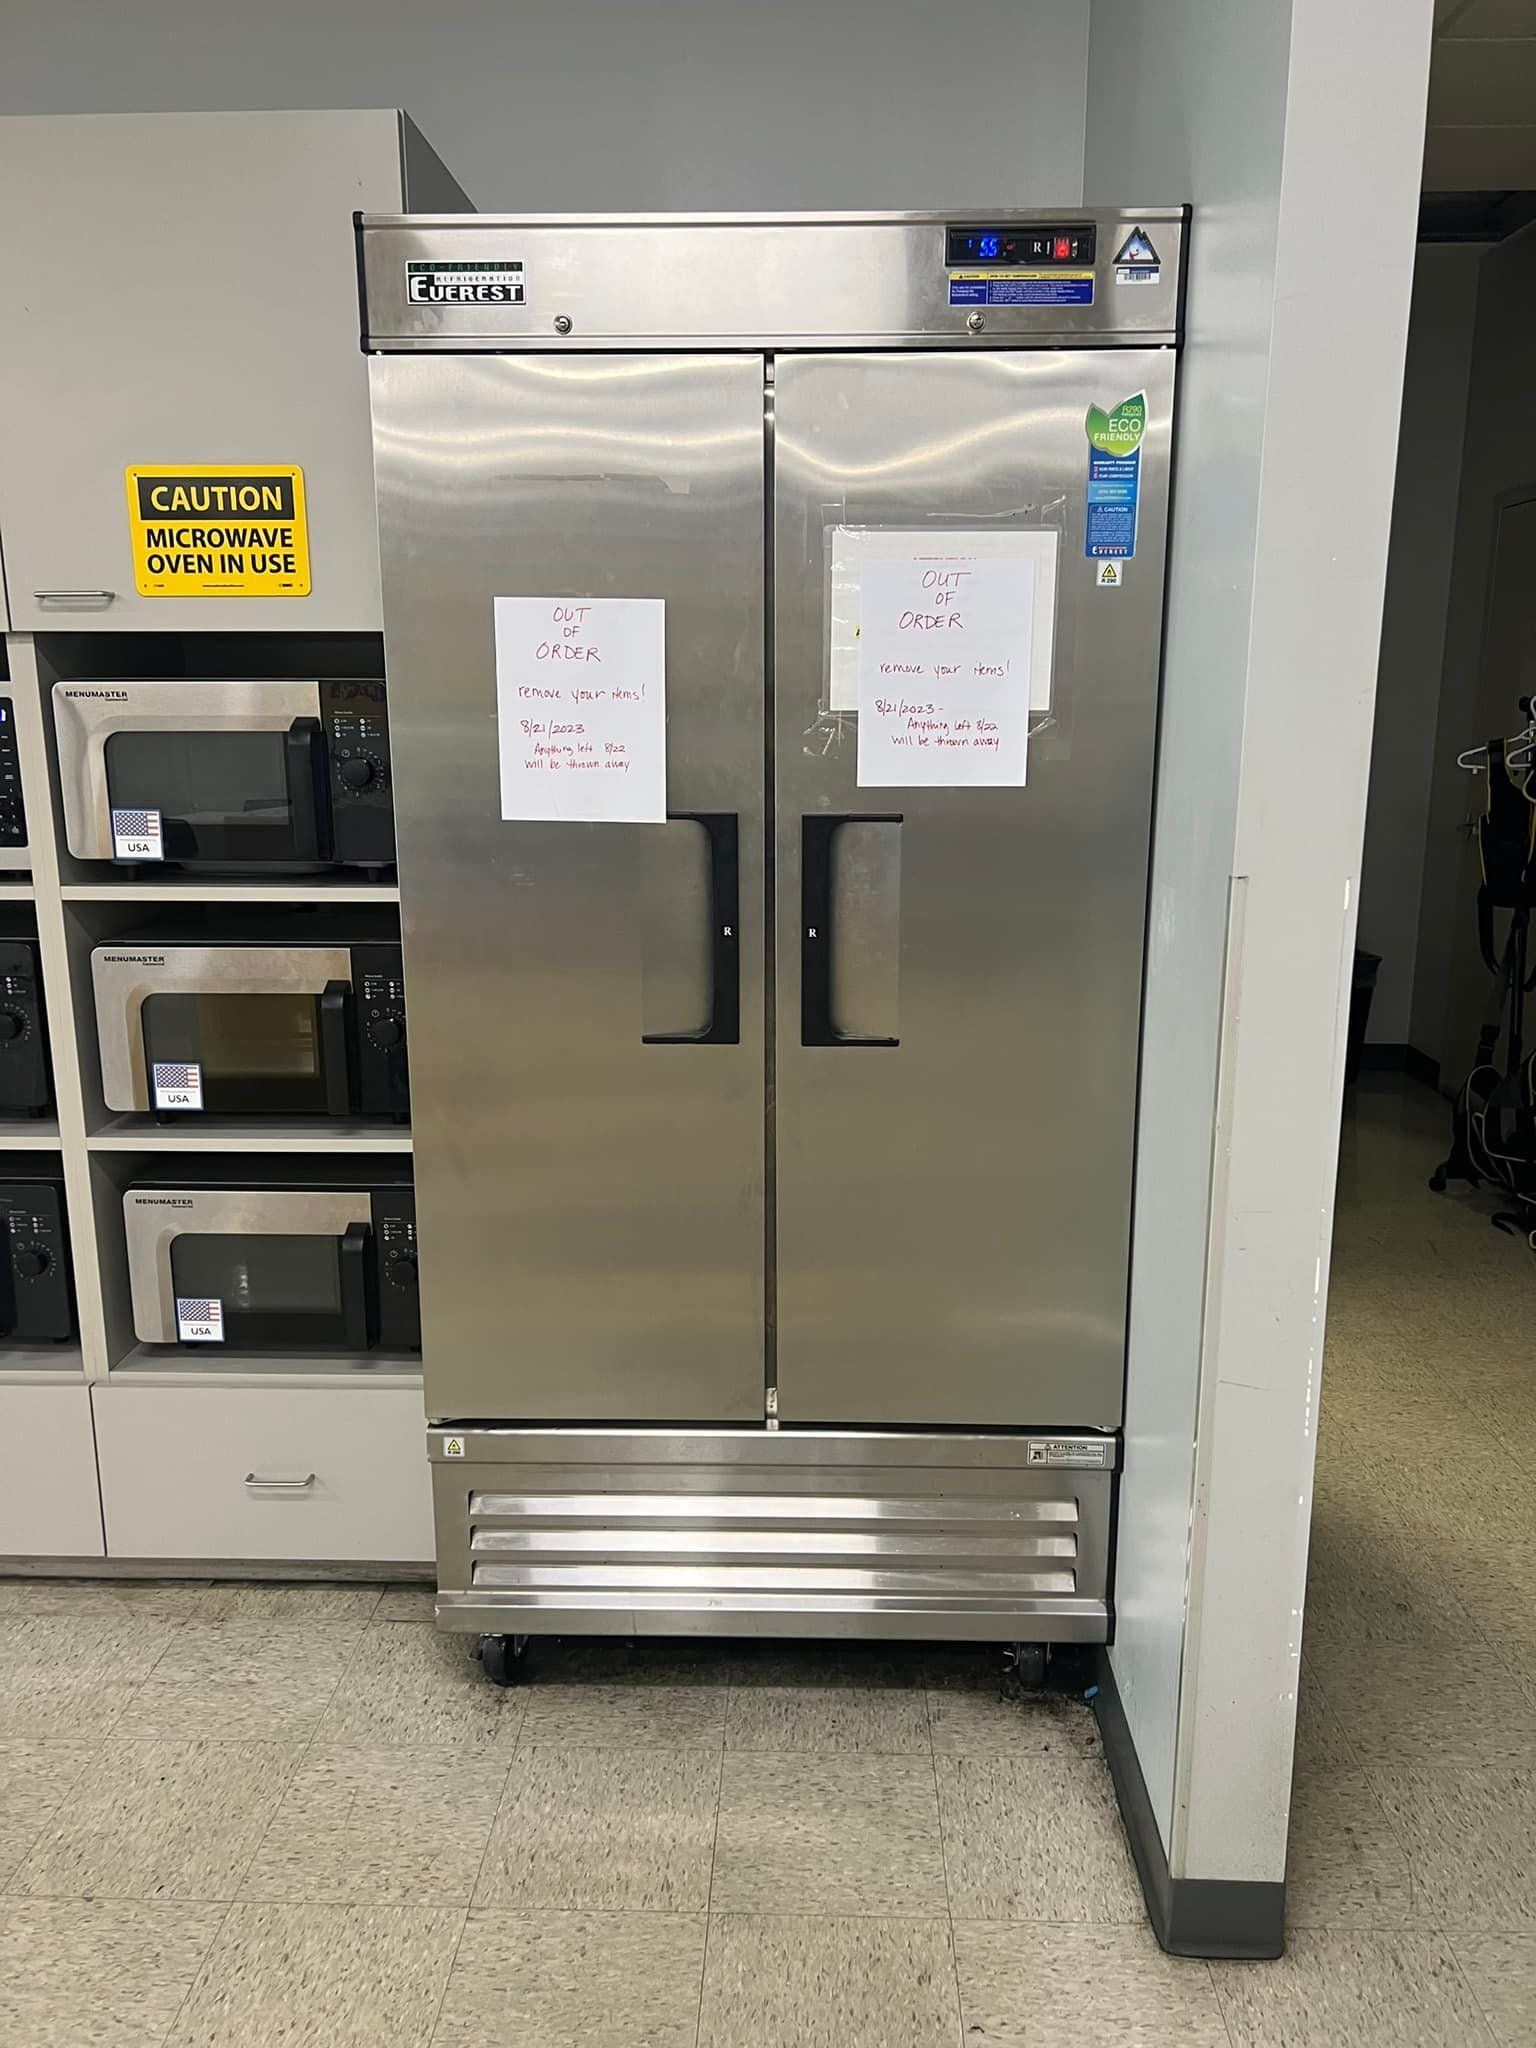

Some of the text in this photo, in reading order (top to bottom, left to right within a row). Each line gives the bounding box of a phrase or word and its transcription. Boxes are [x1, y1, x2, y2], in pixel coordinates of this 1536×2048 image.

[1033, 242, 1042, 253] R
[410, 276, 521, 301] EVEREST
[1109, 419, 1141, 432] ECO
[1094, 433, 1140, 441] FRIENDLY
[151, 486, 282, 512] CAUTION
[146, 528, 293, 549] MICROWAVE
[147, 554, 296, 574] OVEN IN USE
[921, 570, 971, 588] OUT
[935, 591, 957, 606] OF
[552, 607, 592, 622] OUT
[899, 611, 964, 630] ORDER
[563, 626, 581, 637] OF
[536, 642, 601, 662] ORDER
[879, 660, 1010, 679] remove your items!
[518, 683, 646, 704] remove your items!
[875, 699, 935, 718] 8/21/2023
[520, 718, 585, 740] 8/21/2023
[907, 717, 950, 736] Anything
[976, 718, 999, 733] 8/22
[533, 742, 626, 757] Anything left 8/22
[891, 735, 1000, 752] will be thrown away
[524, 759, 630, 774] will be thrown away
[127, 843, 150, 852] USA
[723, 926, 732, 936] R
[808, 928, 817, 938] R
[167, 1094, 189, 1103] USA
[191, 1327, 211, 1335] USA
